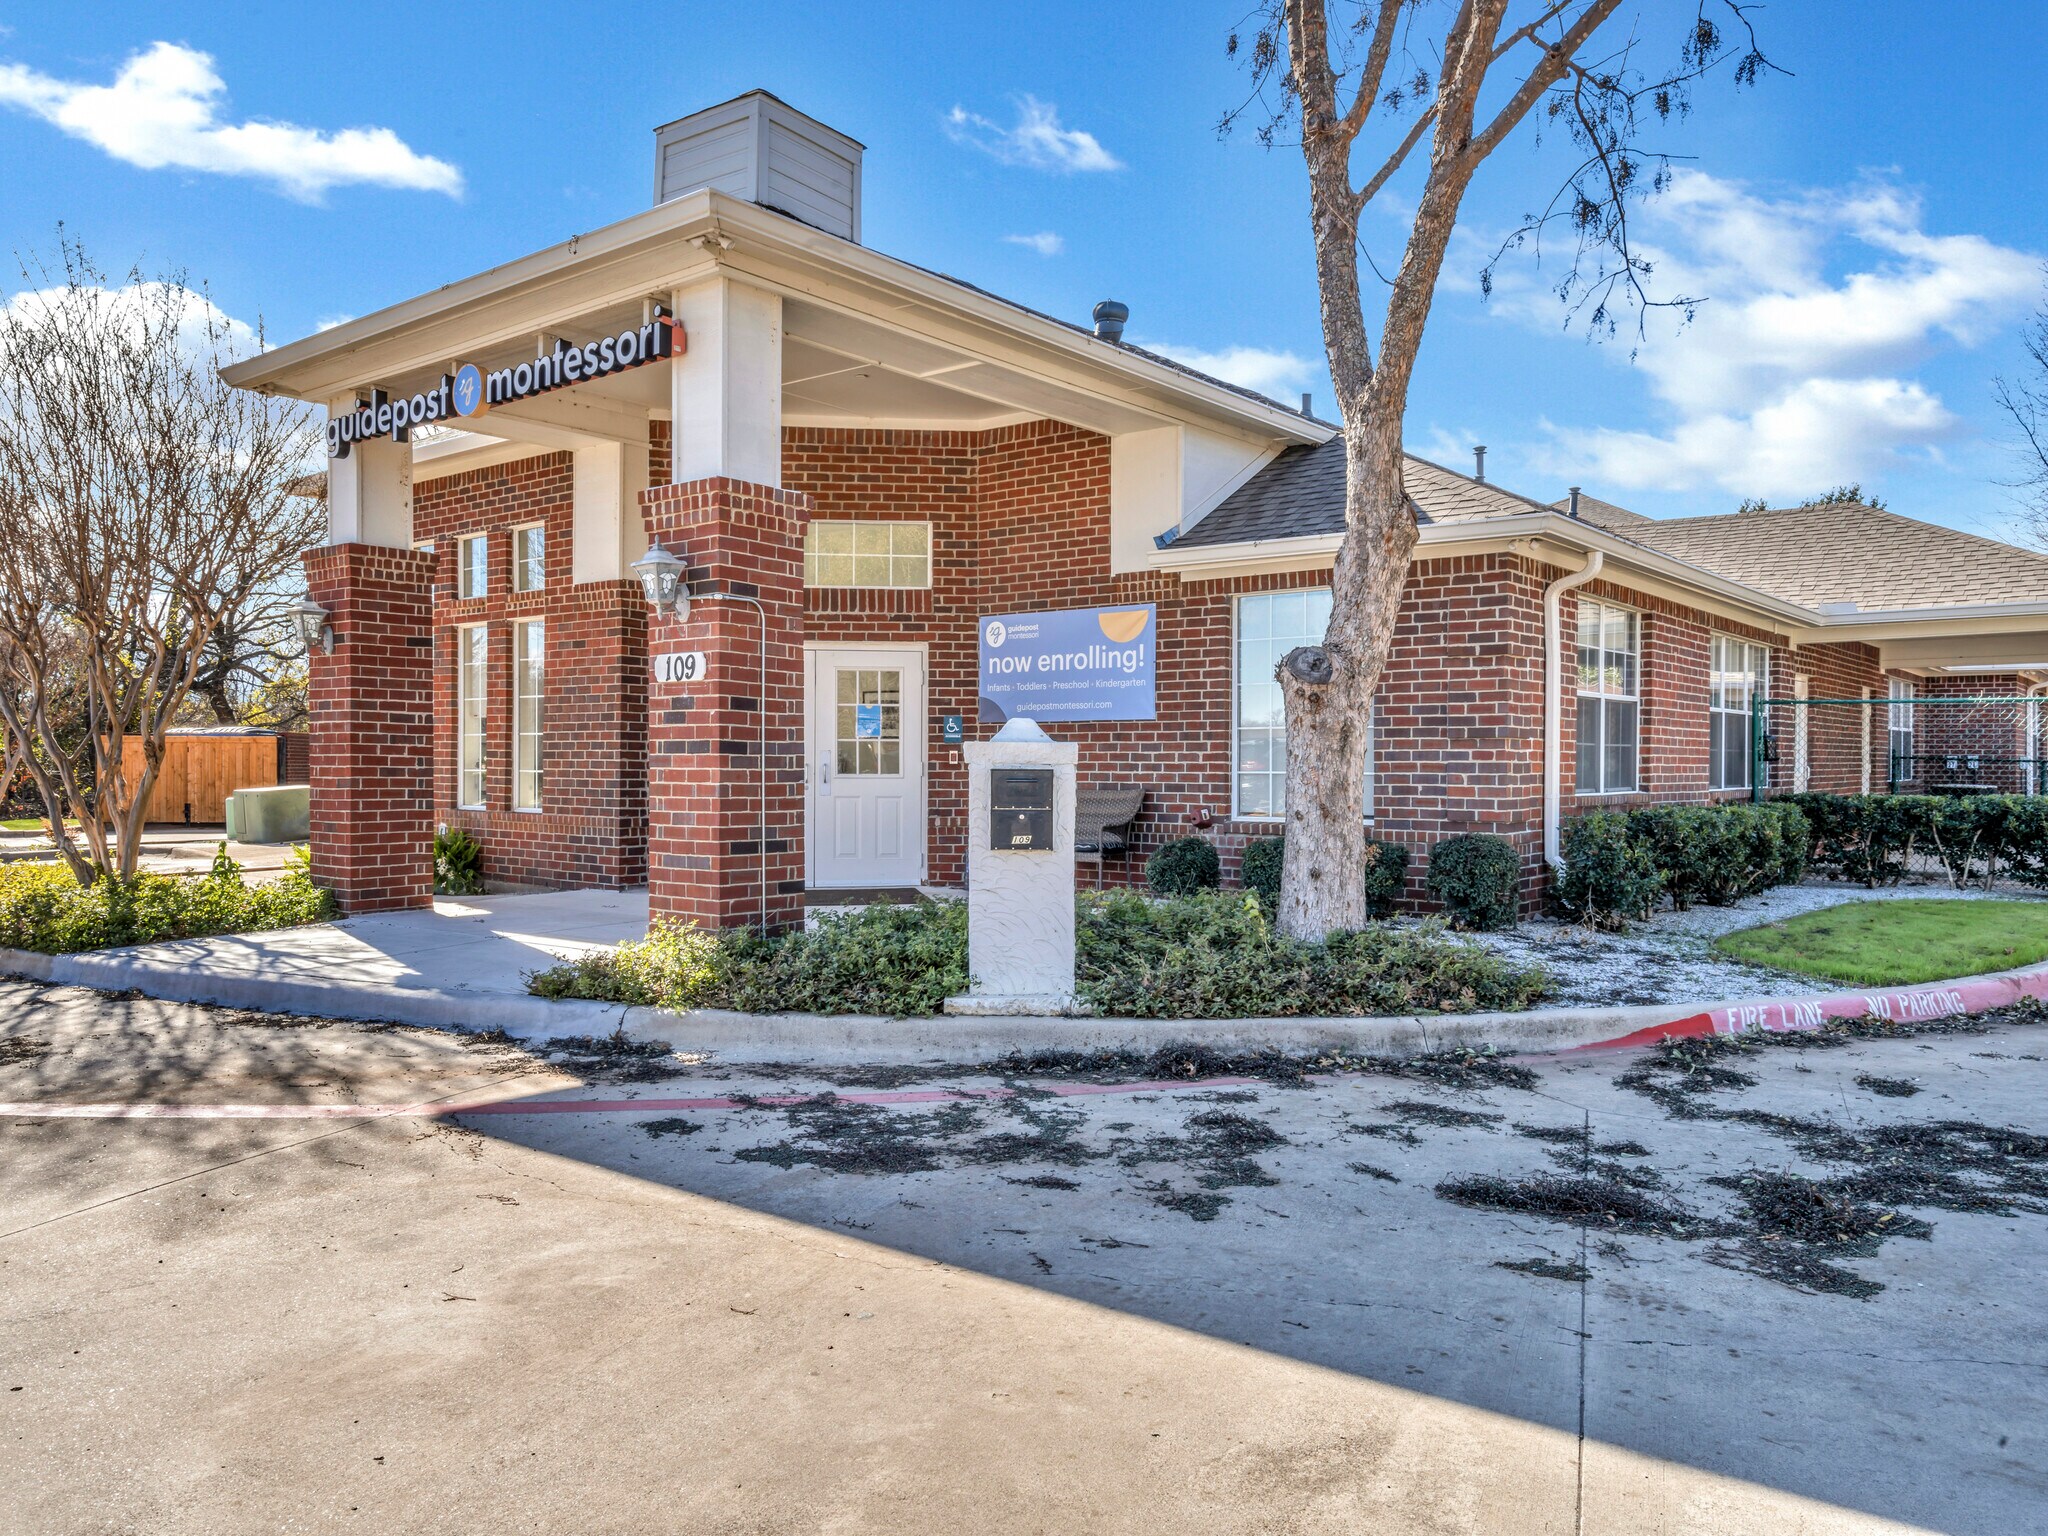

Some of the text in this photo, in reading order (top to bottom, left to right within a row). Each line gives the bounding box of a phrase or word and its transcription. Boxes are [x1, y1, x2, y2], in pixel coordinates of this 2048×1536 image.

[326, 374, 449, 458] guidepost
[486, 304, 661, 404] montessori
[1007, 624, 1039, 633] guidepost
[1007, 631, 1040, 639] montessori
[988, 643, 1145, 674] now enrolling!
[665, 654, 696, 682] 109
[987, 677, 1147, 692] Infants Toddlers Preschool Kindergarten
[1016, 700, 1113, 712] guidepostmontessori.com
[1014, 836, 1030, 844] 109
[1726, 991, 1966, 1034] FIRE LANE NO PARKING
